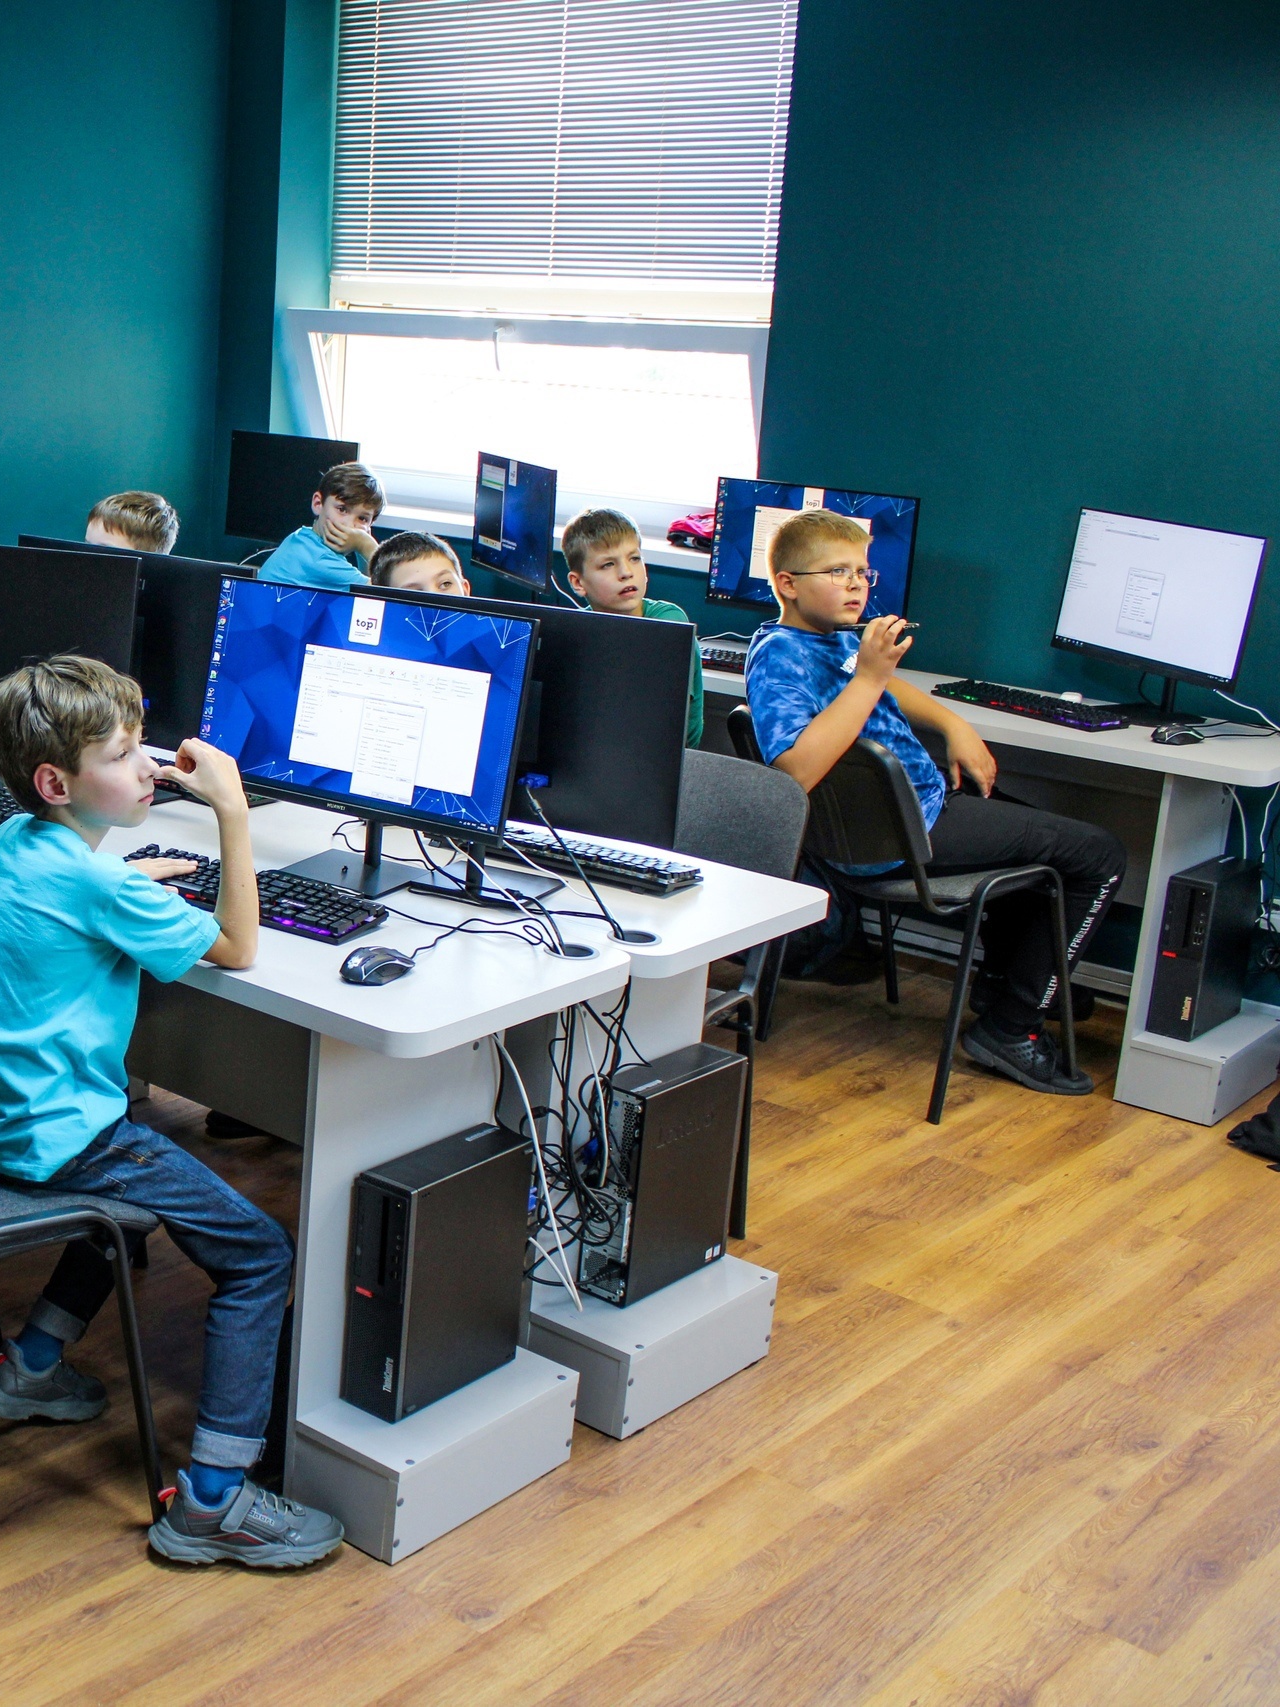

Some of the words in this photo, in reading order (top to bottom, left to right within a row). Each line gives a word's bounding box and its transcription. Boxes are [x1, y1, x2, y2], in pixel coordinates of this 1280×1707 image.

[356, 618, 374, 630] top
[326, 802, 346, 811] HUAWEI
[1039, 976, 1058, 1008] PROBLEM
[1070, 917, 1095, 948] PROBLEM
